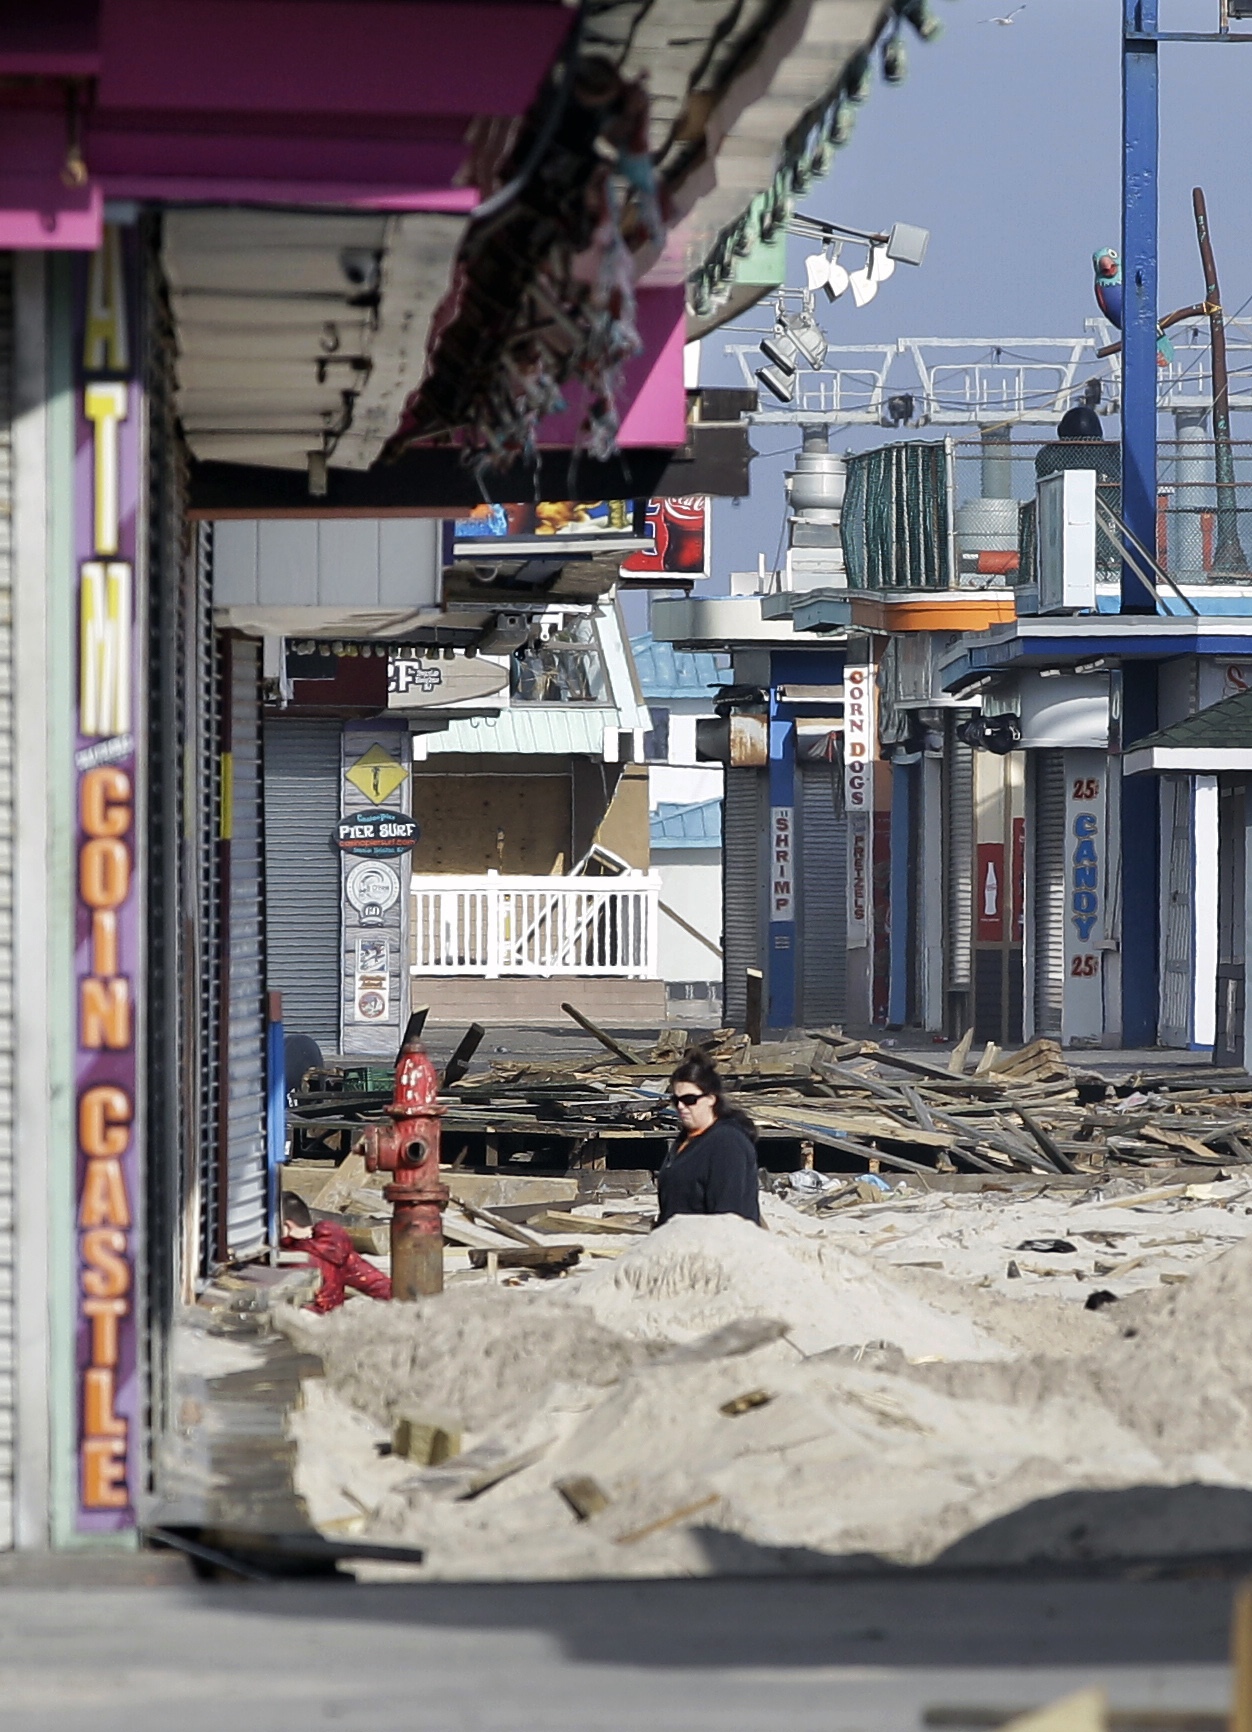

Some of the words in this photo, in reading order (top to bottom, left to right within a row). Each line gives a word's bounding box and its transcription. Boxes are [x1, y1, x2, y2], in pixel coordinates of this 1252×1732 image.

[81, 223, 132, 736] ATM
[849, 670, 865, 733] CORN
[849, 742, 866, 806] DOGS
[339, 824, 375, 839] PIER
[379, 822, 416, 838] SURF
[774, 817, 791, 911] SHRIMP
[854, 835, 866, 920] PRETZELS
[1071, 812, 1099, 942] CANDY
[79, 765, 133, 1049] COIN
[78, 1086, 133, 1509] CASTLE
